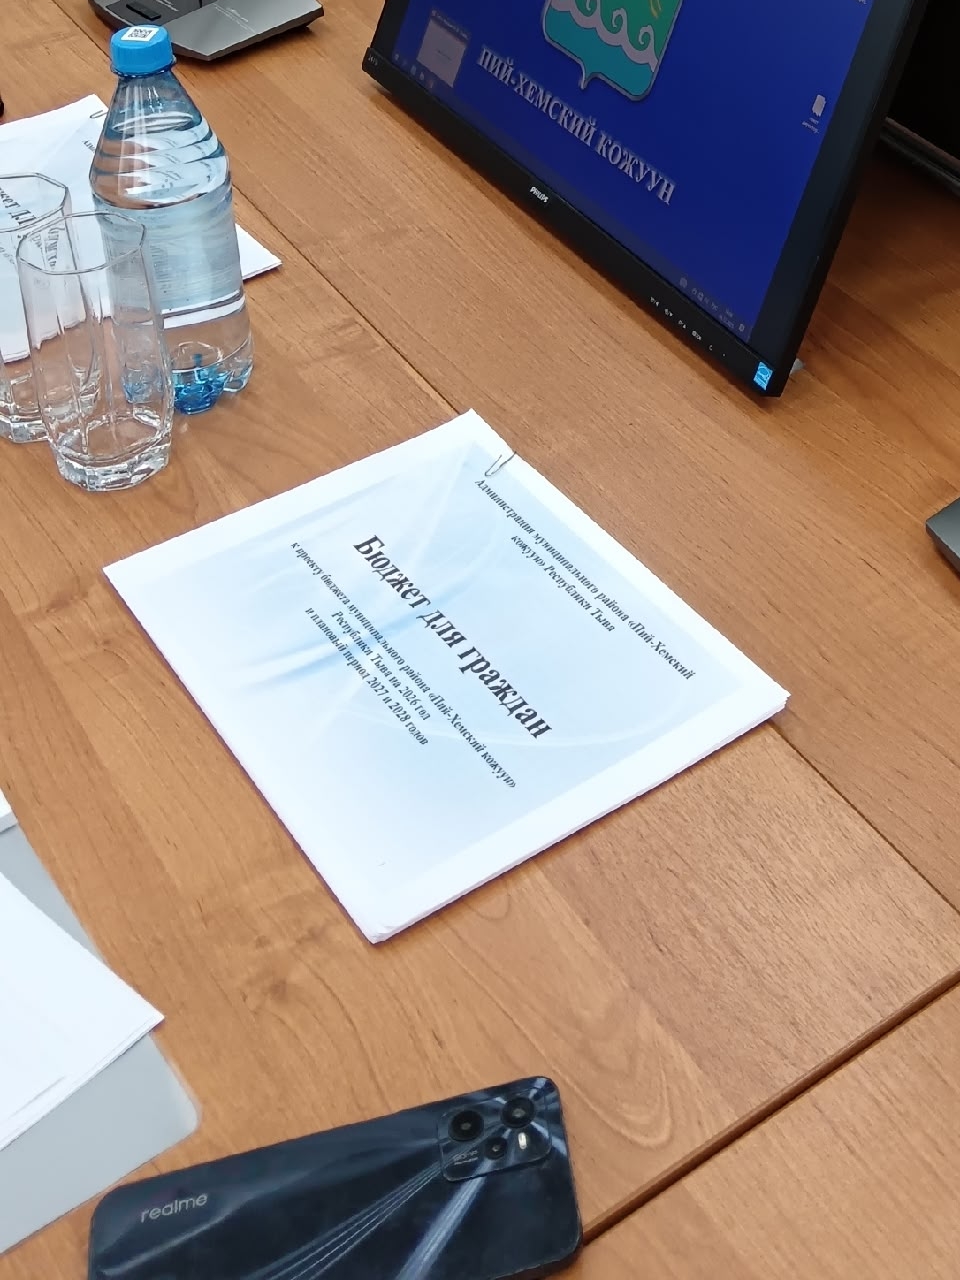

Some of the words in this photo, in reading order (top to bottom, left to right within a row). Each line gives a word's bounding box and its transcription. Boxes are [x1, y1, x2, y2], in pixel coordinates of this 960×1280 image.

[477, 47, 597, 147] ПИЙ-ХЕМСКИЙ
[595, 129, 676, 205] КОЖУУН
[296, 549, 324, 577] проекту
[321, 574, 350, 606] бюджета
[348, 603, 406, 666] муниципального
[402, 664, 430, 694] района
[429, 692, 486, 754] «Пий-Хемский
[353, 534, 431, 609] Бюджет
[416, 609, 467, 648] для
[457, 646, 552, 739] граждан
[475, 479, 535, 535] Администрация
[532, 532, 599, 594] муниципального
[594, 591, 629, 622] района
[627, 619, 696, 680] «Пий-Хемский
[543, 565, 591, 610] Республики
[589, 608, 615, 632] Тыва
[309, 613, 346, 654] плановый
[343, 648, 369, 679] период
[365, 676, 386, 697] 2027
[389, 699, 411, 722] 2028
[404, 719, 429, 746] годов
[331, 610, 372, 657] Республики
[370, 653, 393, 679] Тыва
[390, 675, 402, 689] на
[397, 685, 419, 707] 2026
[415, 702, 431, 721] год
[140, 1193, 208, 1224] realme
